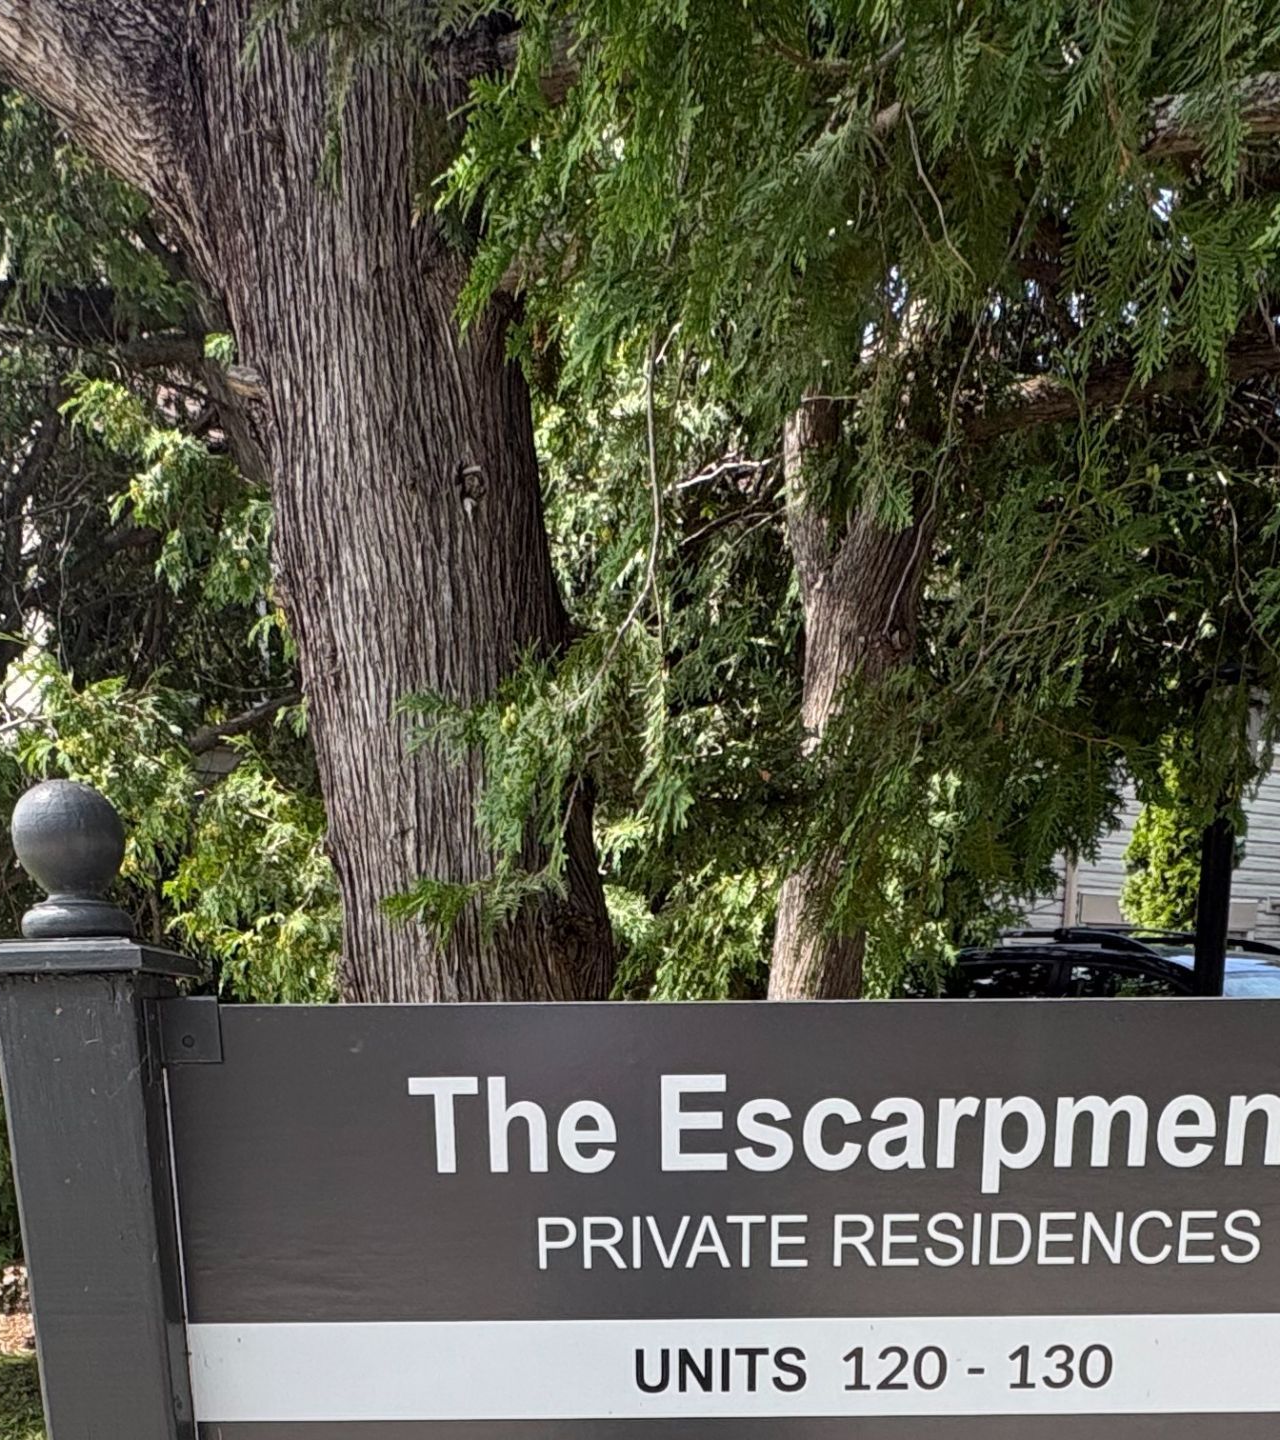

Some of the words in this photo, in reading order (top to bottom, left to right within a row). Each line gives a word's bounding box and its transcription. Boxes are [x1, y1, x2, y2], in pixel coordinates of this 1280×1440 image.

[408, 1076, 617, 1174] The
[537, 1214, 809, 1270] PRIVATE
[833, 1209, 1261, 1267] RESIDENCES
[634, 1346, 807, 1394] UNITS
[842, 1345, 948, 1391] 120
[1008, 1342, 1113, 1389] 130
